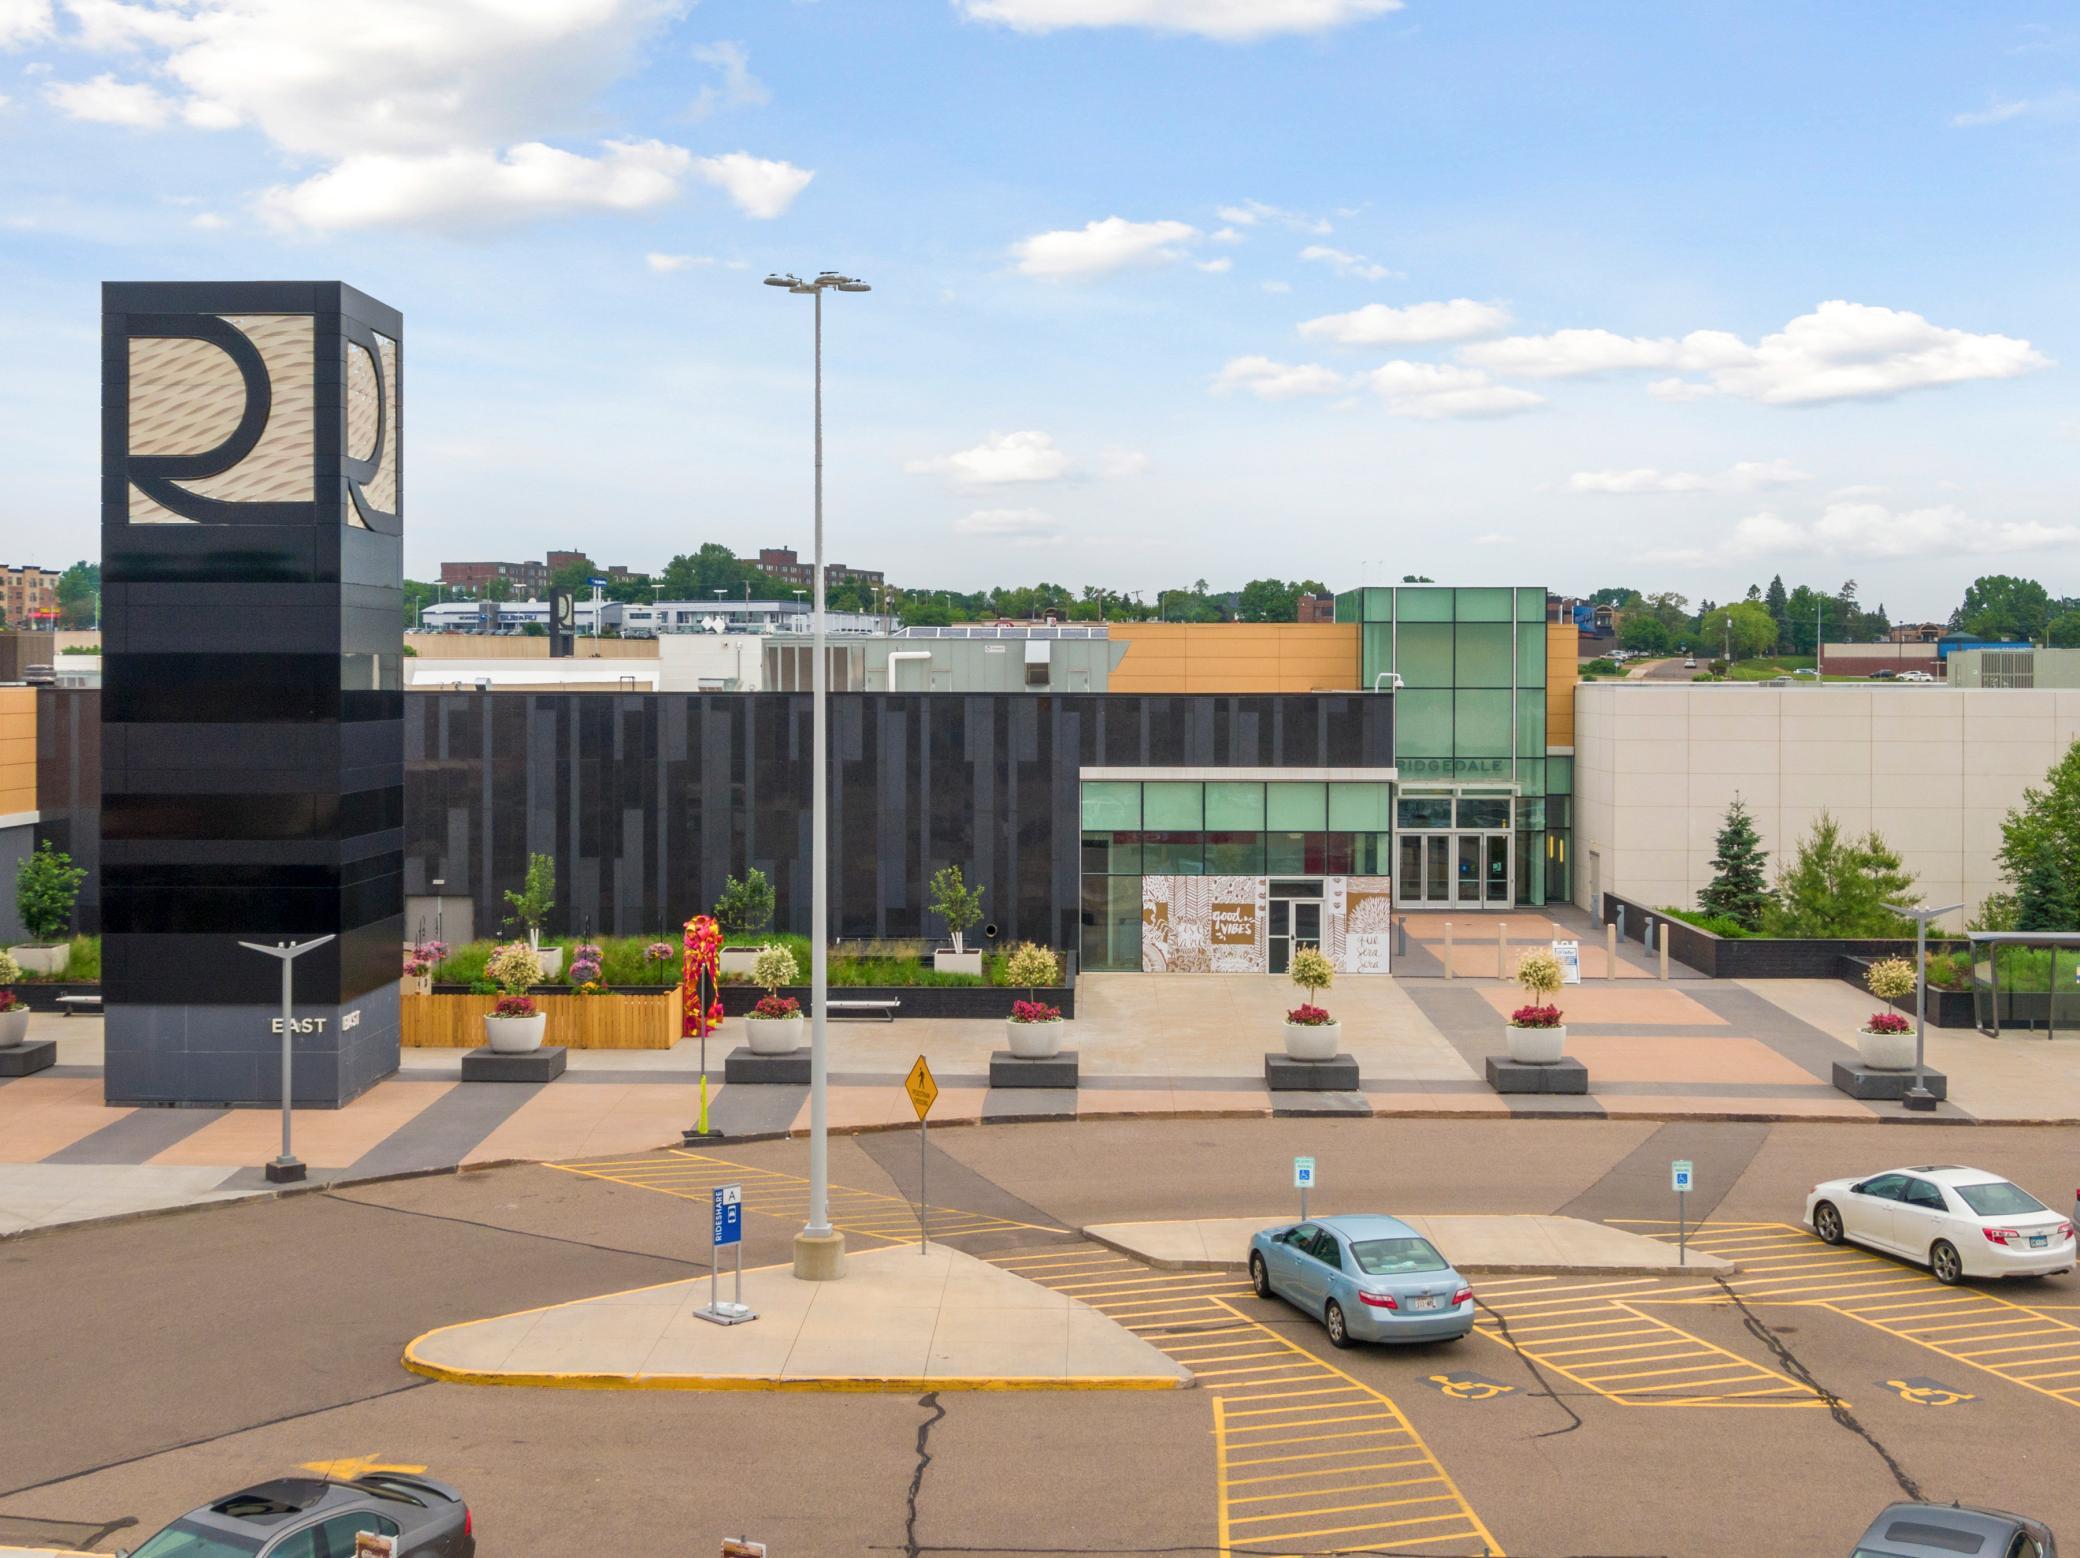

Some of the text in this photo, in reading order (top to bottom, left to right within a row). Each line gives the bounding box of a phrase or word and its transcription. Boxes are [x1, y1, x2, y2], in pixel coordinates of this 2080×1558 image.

[499, 613, 537, 621] SUBARU
[1395, 760, 1503, 772] RIDGEDALE
[1212, 907, 1241, 930] good
[1221, 923, 1252, 935] VIBES
[271, 1018, 327, 1033] EAST
[728, 1190, 736, 1201] A
[715, 1191, 723, 1242] RIDESHARE
